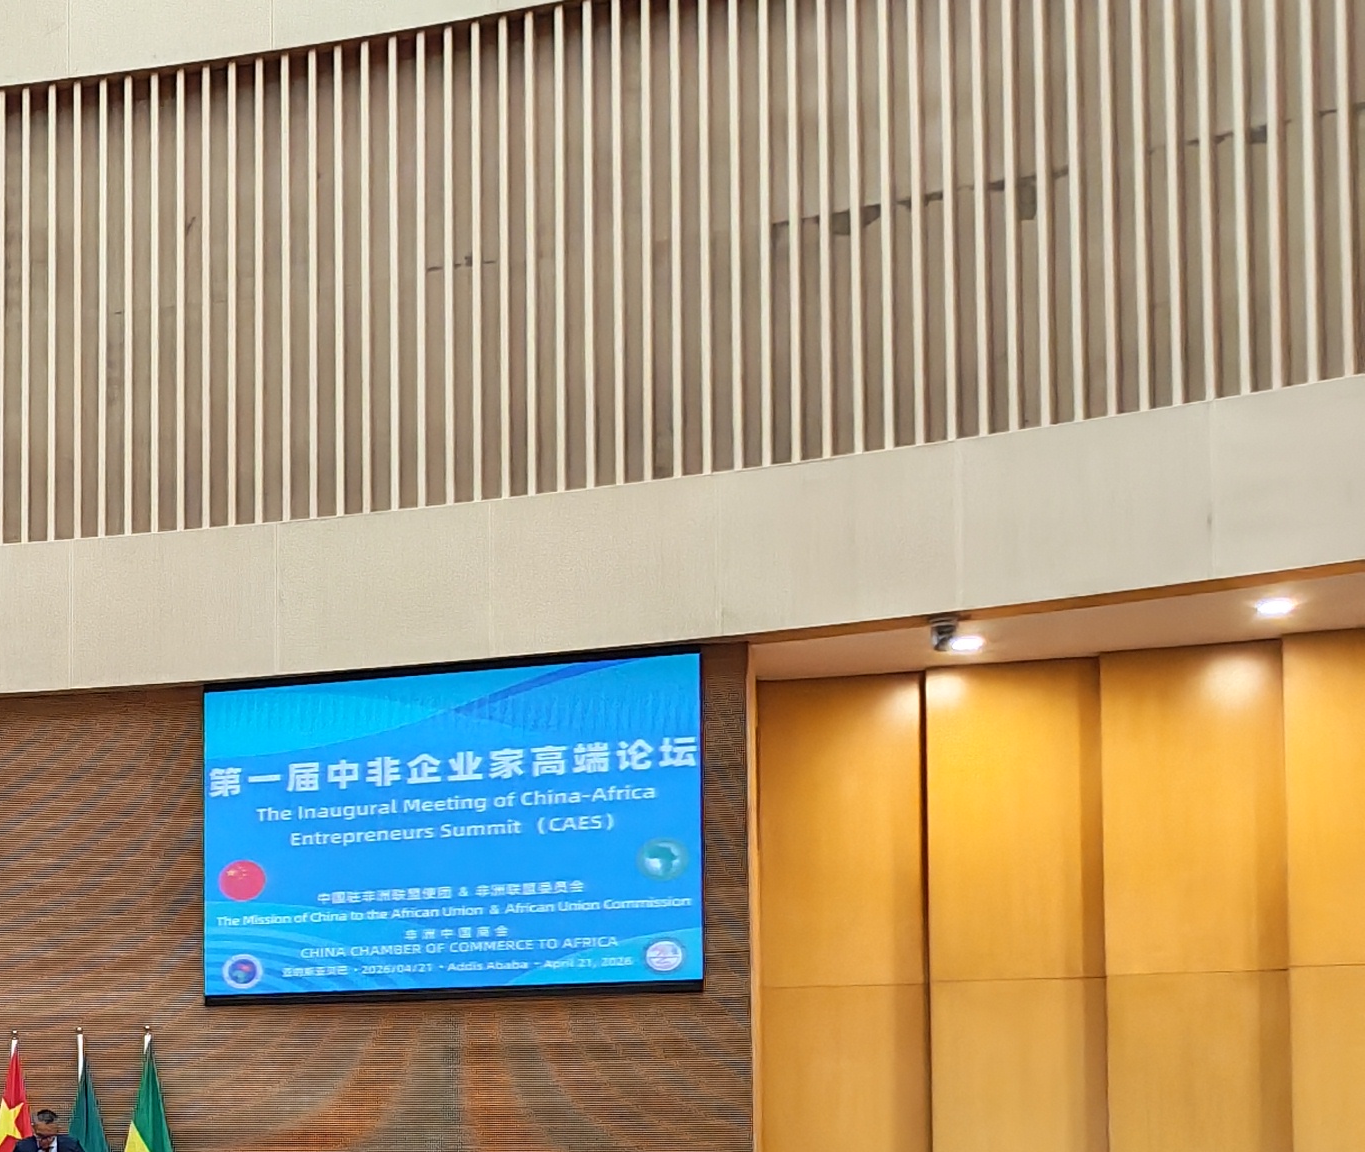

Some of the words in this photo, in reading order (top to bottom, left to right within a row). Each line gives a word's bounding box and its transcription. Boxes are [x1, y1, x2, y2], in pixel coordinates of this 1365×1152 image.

[209, 736, 697, 798] 第一届中非企业家高端论坛
[256, 807, 291, 822] The
[298, 799, 397, 820] Inaugural
[403, 795, 486, 812] Meeting
[493, 792, 515, 807] of
[520, 786, 656, 807] China-Africa
[290, 826, 434, 847] Entrepreneurs
[440, 819, 521, 838] Summit
[458, 887, 469, 897] &
[216, 915, 240, 926] The
[243, 913, 292, 925] Mission
[294, 912, 308, 923] of
[310, 911, 347, 923] China
[351, 910, 364, 921] to
[367, 908, 387, 920] the
[391, 907, 439, 919] African
[442, 905, 483, 916] Union
[489, 904, 500, 915] &
[505, 902, 555, 914] African
[558, 899, 600, 912] Union
[603, 896, 692, 911] Commission
[300, 947, 345, 959] CHINA
[350, 944, 421, 957] CHAMBER
[426, 942, 445, 954] OF
[450, 938, 534, 953] COMMERCE
[539, 938, 557, 949] TO
[562, 936, 618, 949] AFRICA
[447, 961, 483, 971] Addis
[486, 960, 528, 970] Ababa
